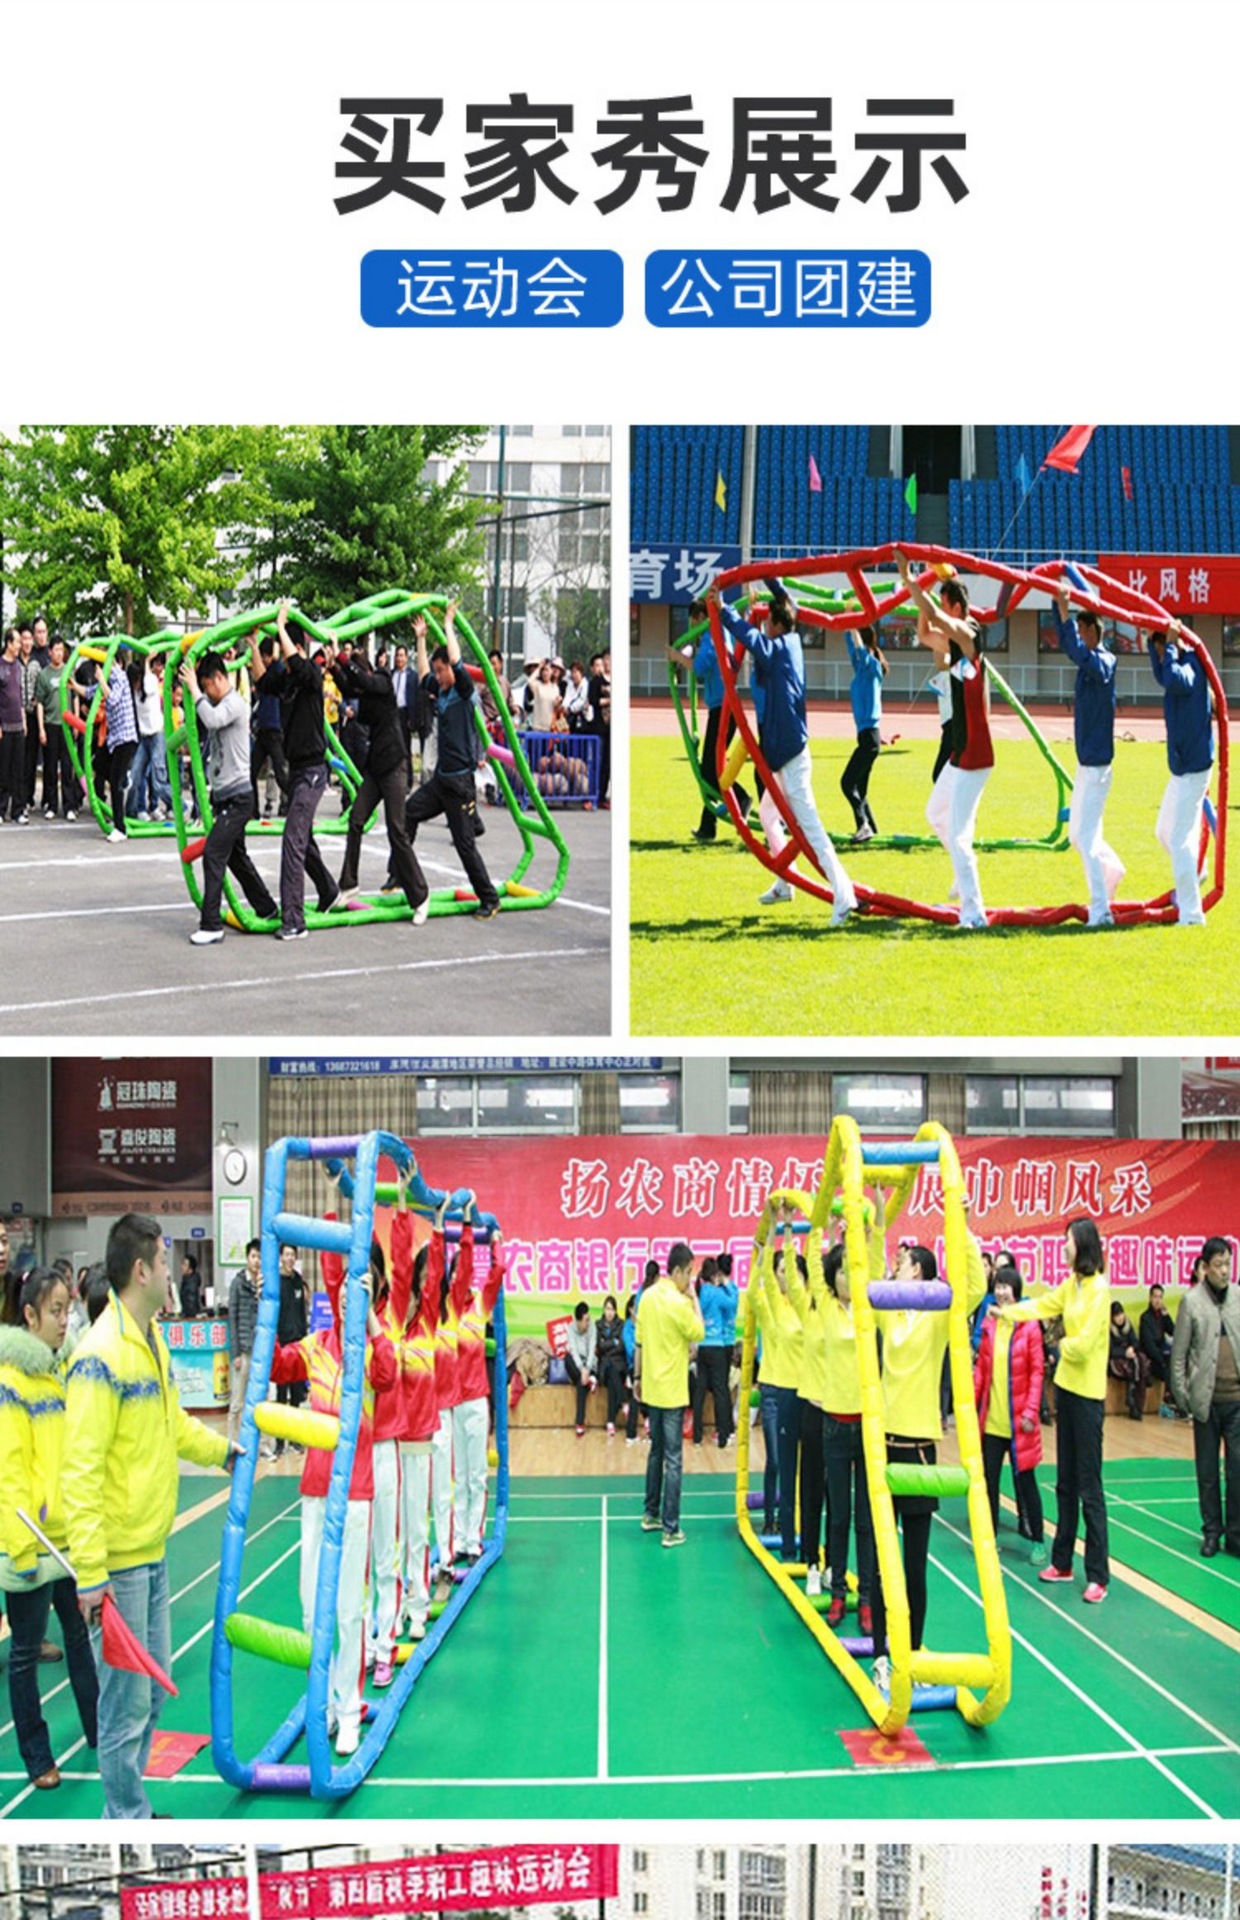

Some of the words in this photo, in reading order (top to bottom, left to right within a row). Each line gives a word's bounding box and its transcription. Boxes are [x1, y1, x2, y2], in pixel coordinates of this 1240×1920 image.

[630, 549, 724, 602] 育场
[1128, 567, 1210, 603] 比风格
